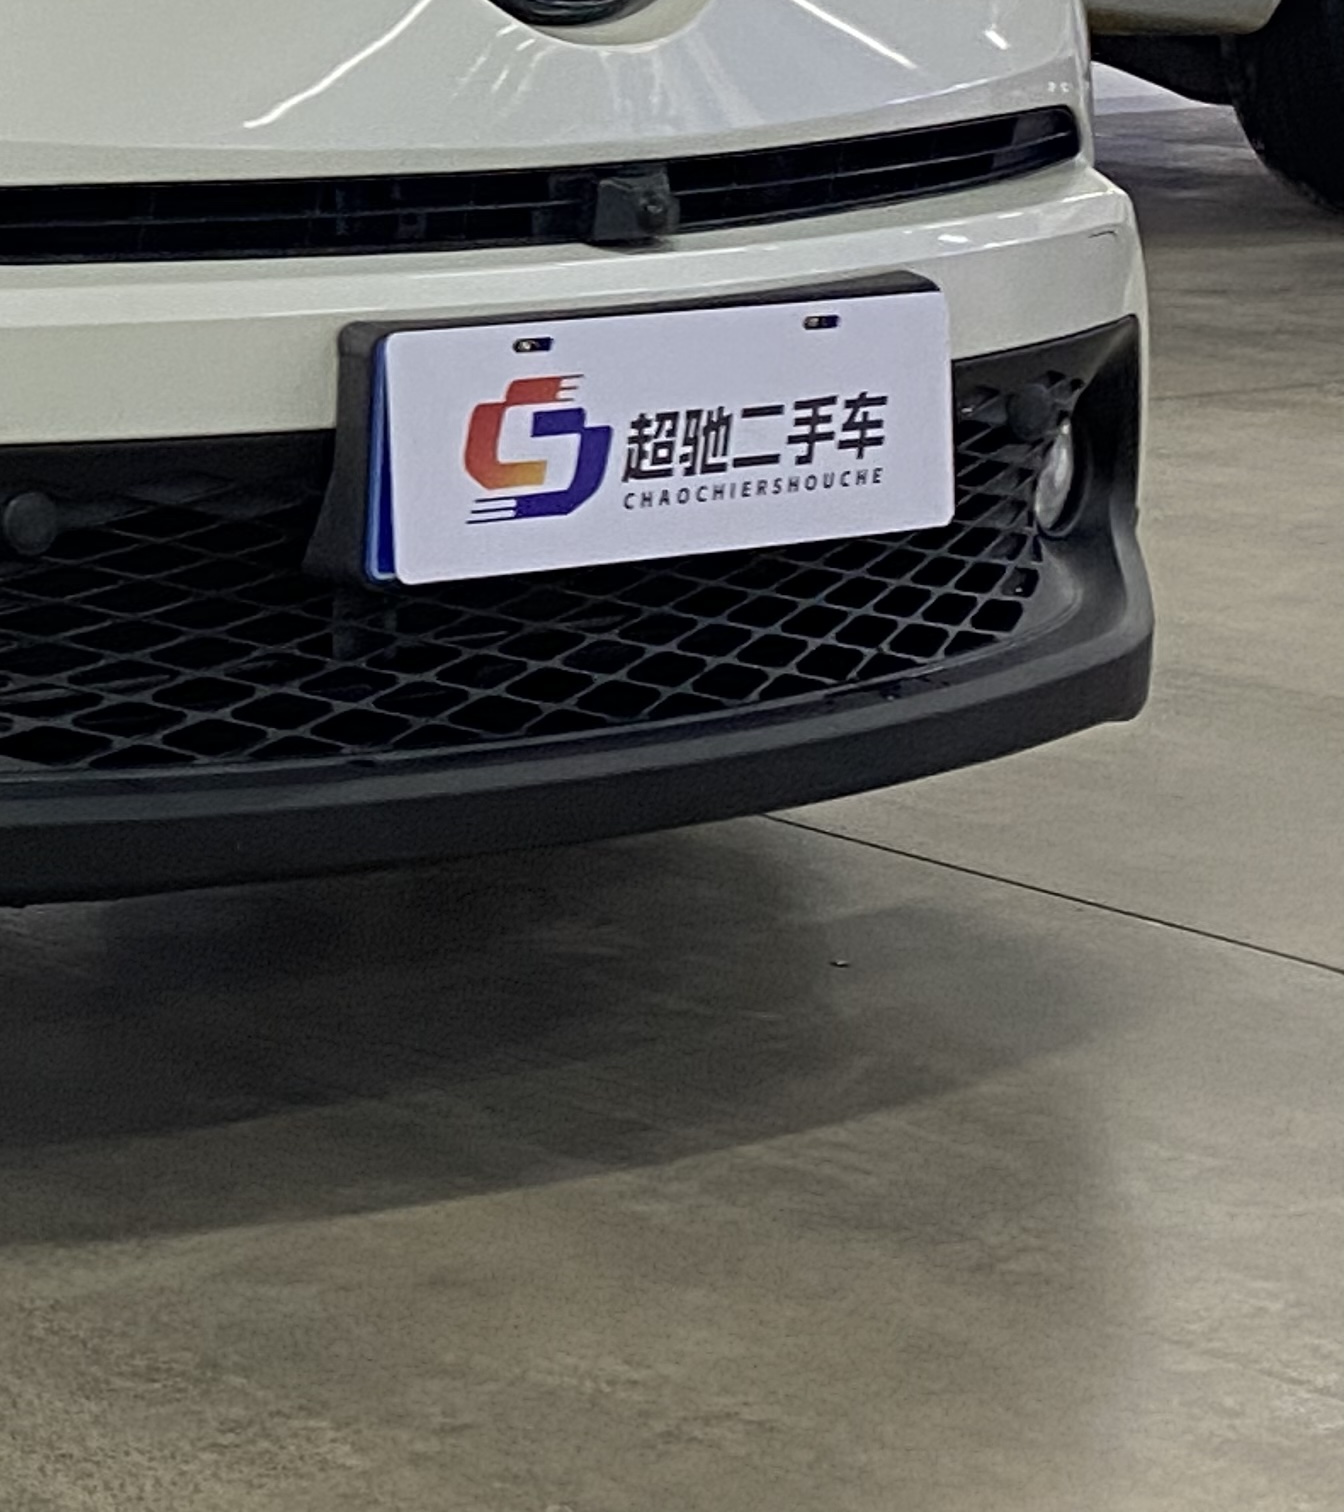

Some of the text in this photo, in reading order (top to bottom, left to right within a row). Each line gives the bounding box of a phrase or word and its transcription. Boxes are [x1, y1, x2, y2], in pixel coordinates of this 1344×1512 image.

[620, 390, 889, 484] 超驰二手车
[622, 467, 884, 510] CHAOCHIERSHOUCHE
